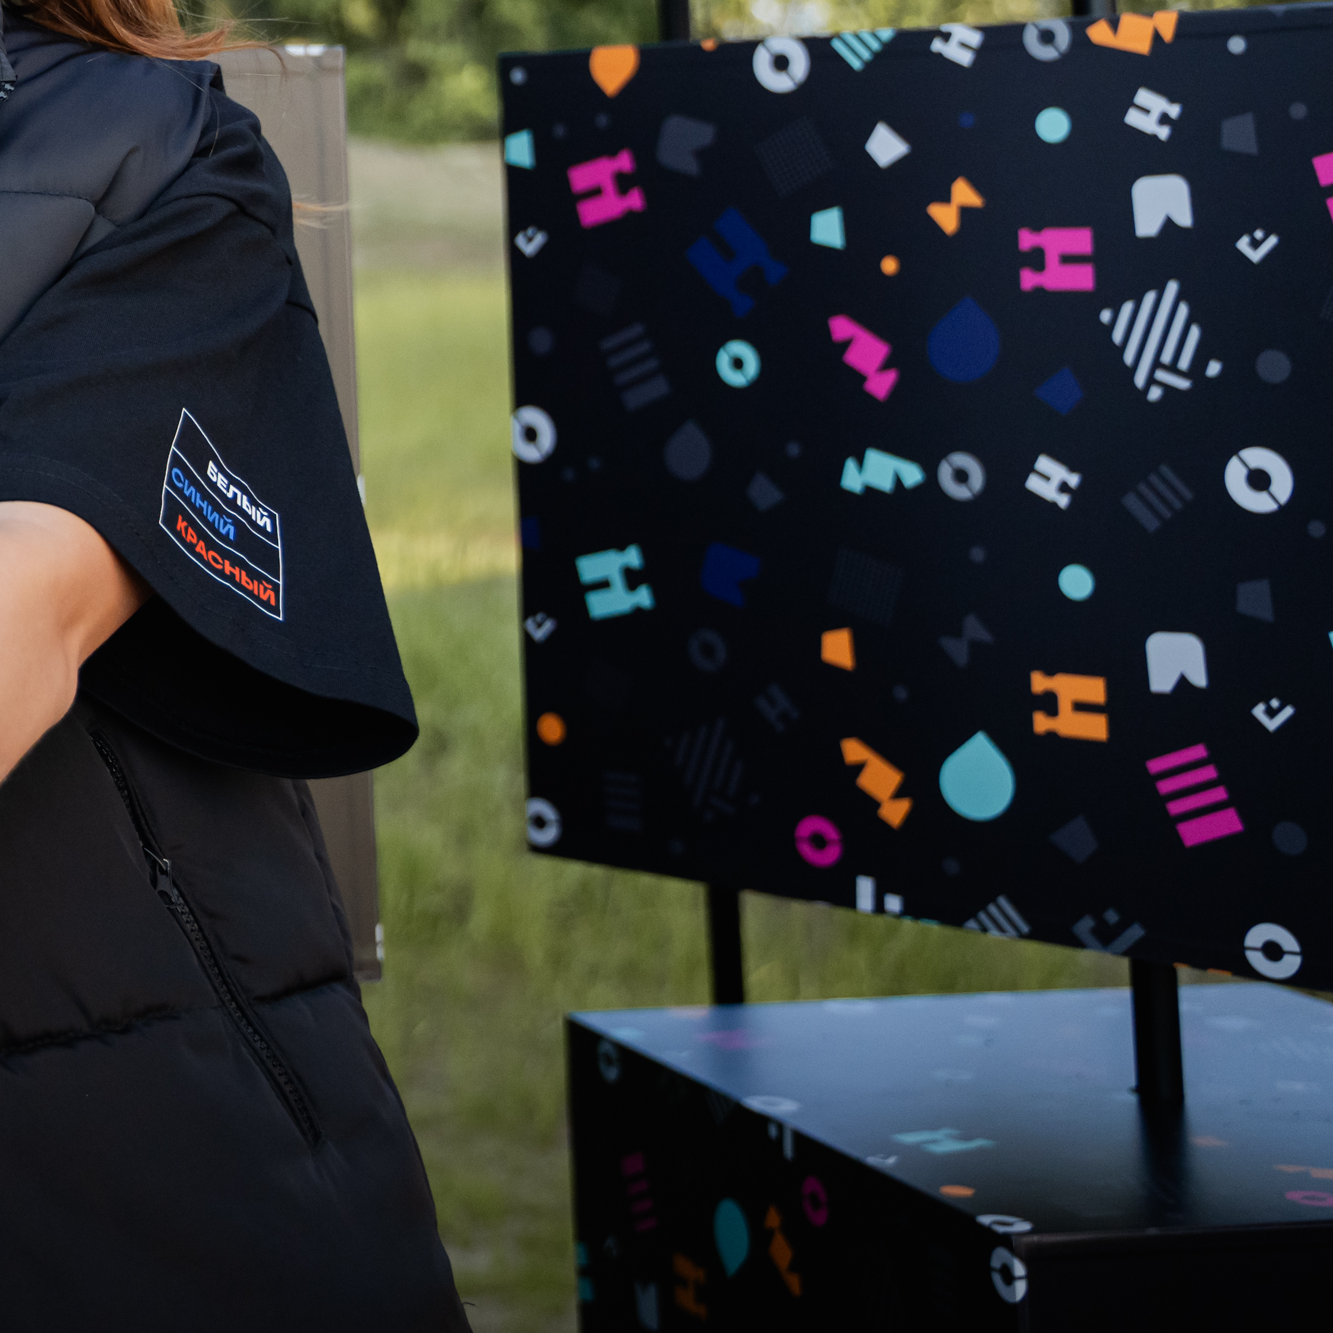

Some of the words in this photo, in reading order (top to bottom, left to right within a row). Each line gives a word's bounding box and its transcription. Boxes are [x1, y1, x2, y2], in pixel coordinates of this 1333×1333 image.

[171, 467, 236, 541] СИНИЙ
[207, 460, 272, 532] БЕЛЫЙ
[176, 514, 276, 606] КРАСНЫЙ
